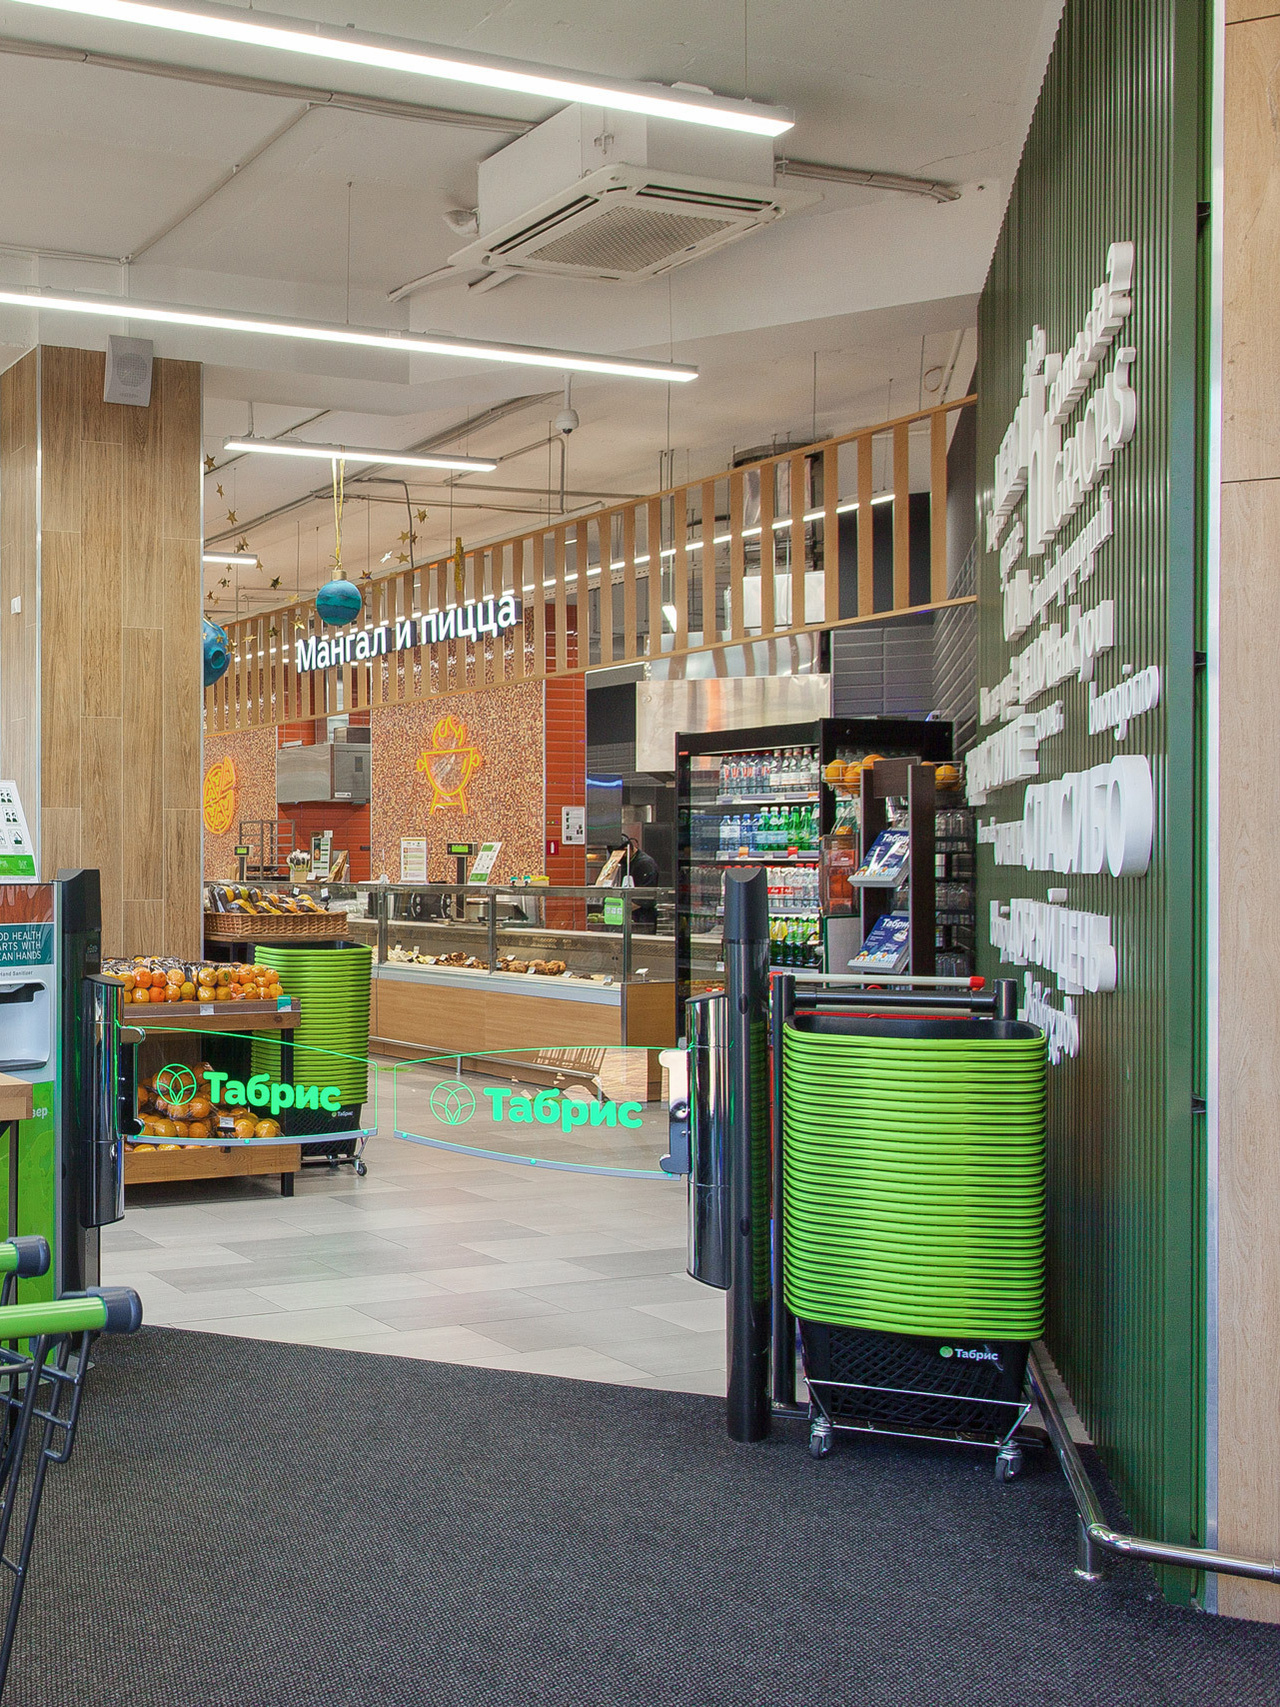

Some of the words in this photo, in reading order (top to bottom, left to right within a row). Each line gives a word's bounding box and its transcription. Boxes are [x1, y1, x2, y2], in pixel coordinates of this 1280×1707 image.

[296, 627, 388, 673] Мангал
[396, 619, 411, 651] и
[420, 595, 518, 643] пицца
[1024, 754, 1152, 878] СПАСИБО
[12, 931, 42, 941] HEALTH
[21, 941, 42, 950] WITH
[15, 951, 42, 961] HANDS
[203, 1071, 341, 1115] Табрис
[483, 1086, 644, 1132] Табрис
[954, 1348, 999, 1361] Табрис
